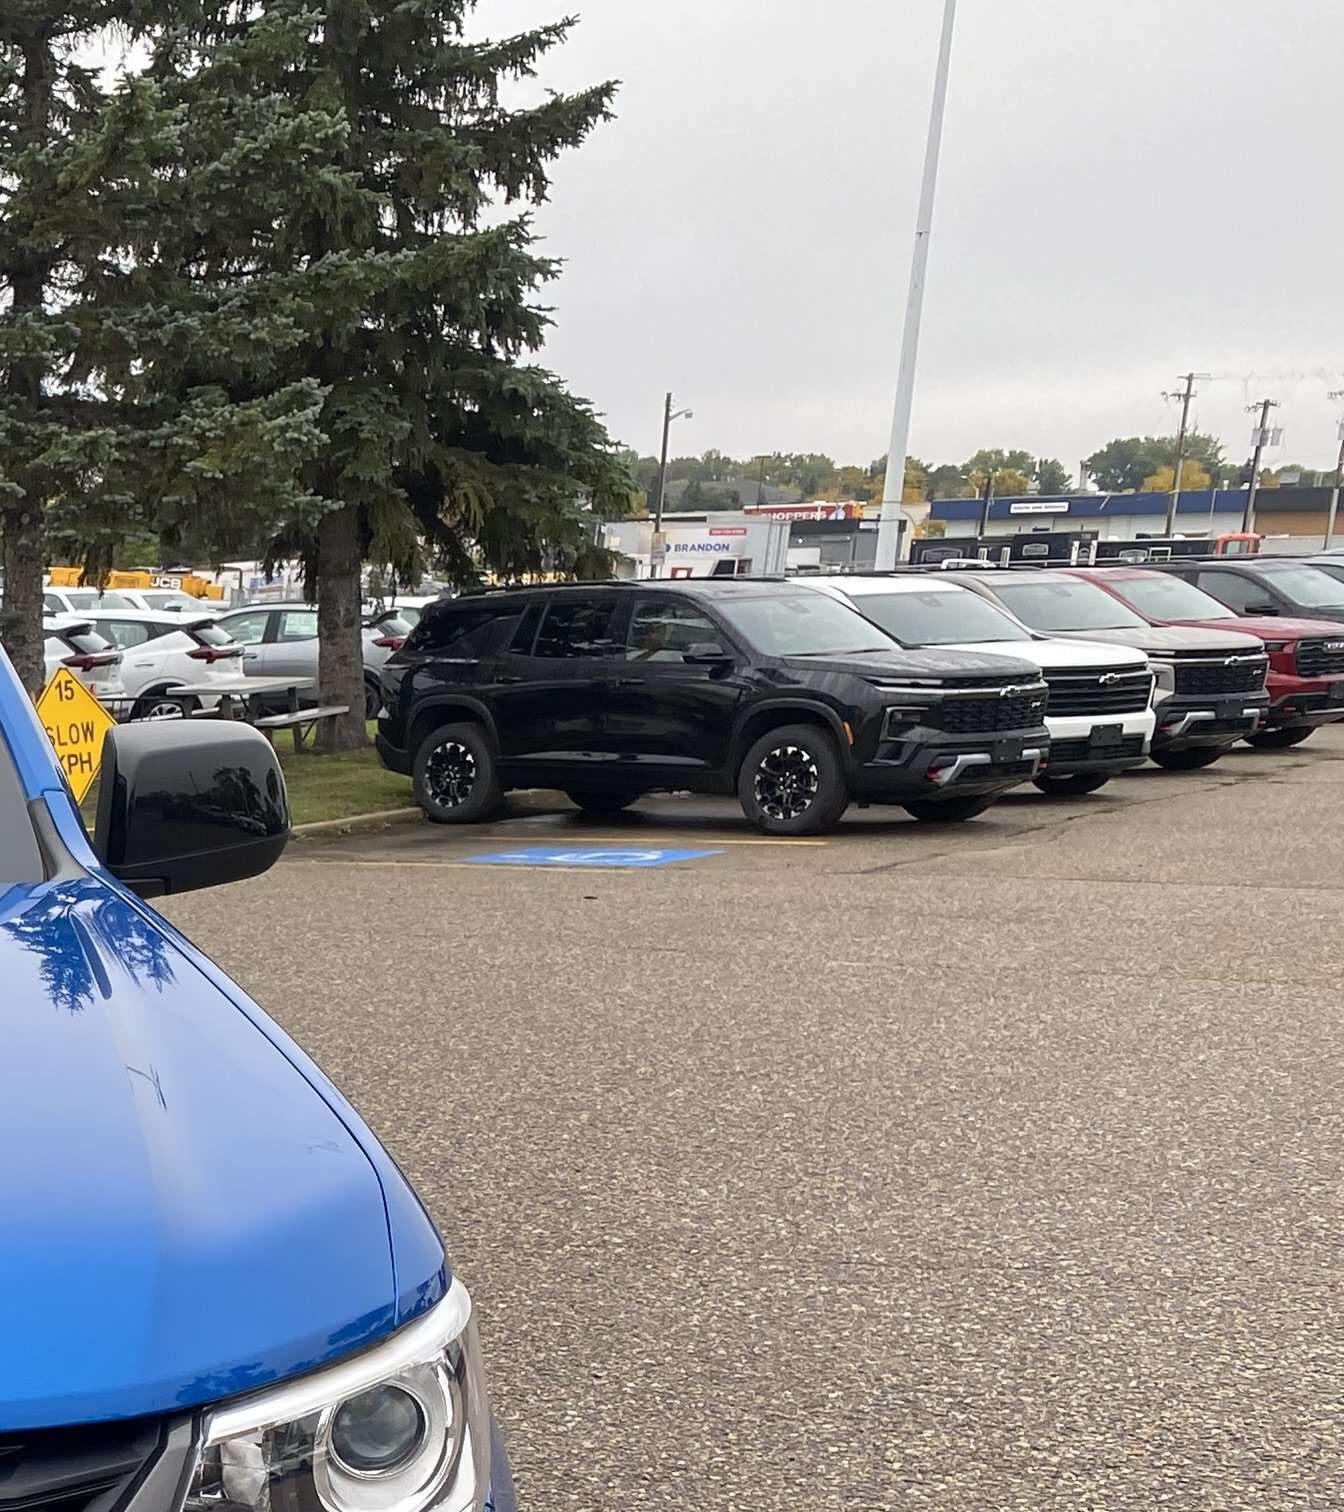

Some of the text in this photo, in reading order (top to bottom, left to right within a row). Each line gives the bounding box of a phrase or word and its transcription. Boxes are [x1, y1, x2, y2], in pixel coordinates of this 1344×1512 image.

[761, 511, 826, 520] HOPPERS
[674, 543, 730, 553] BRANDON
[150, 576, 182, 590] JCB
[55, 679, 75, 702] 15
[45, 720, 94, 747] SLOW
